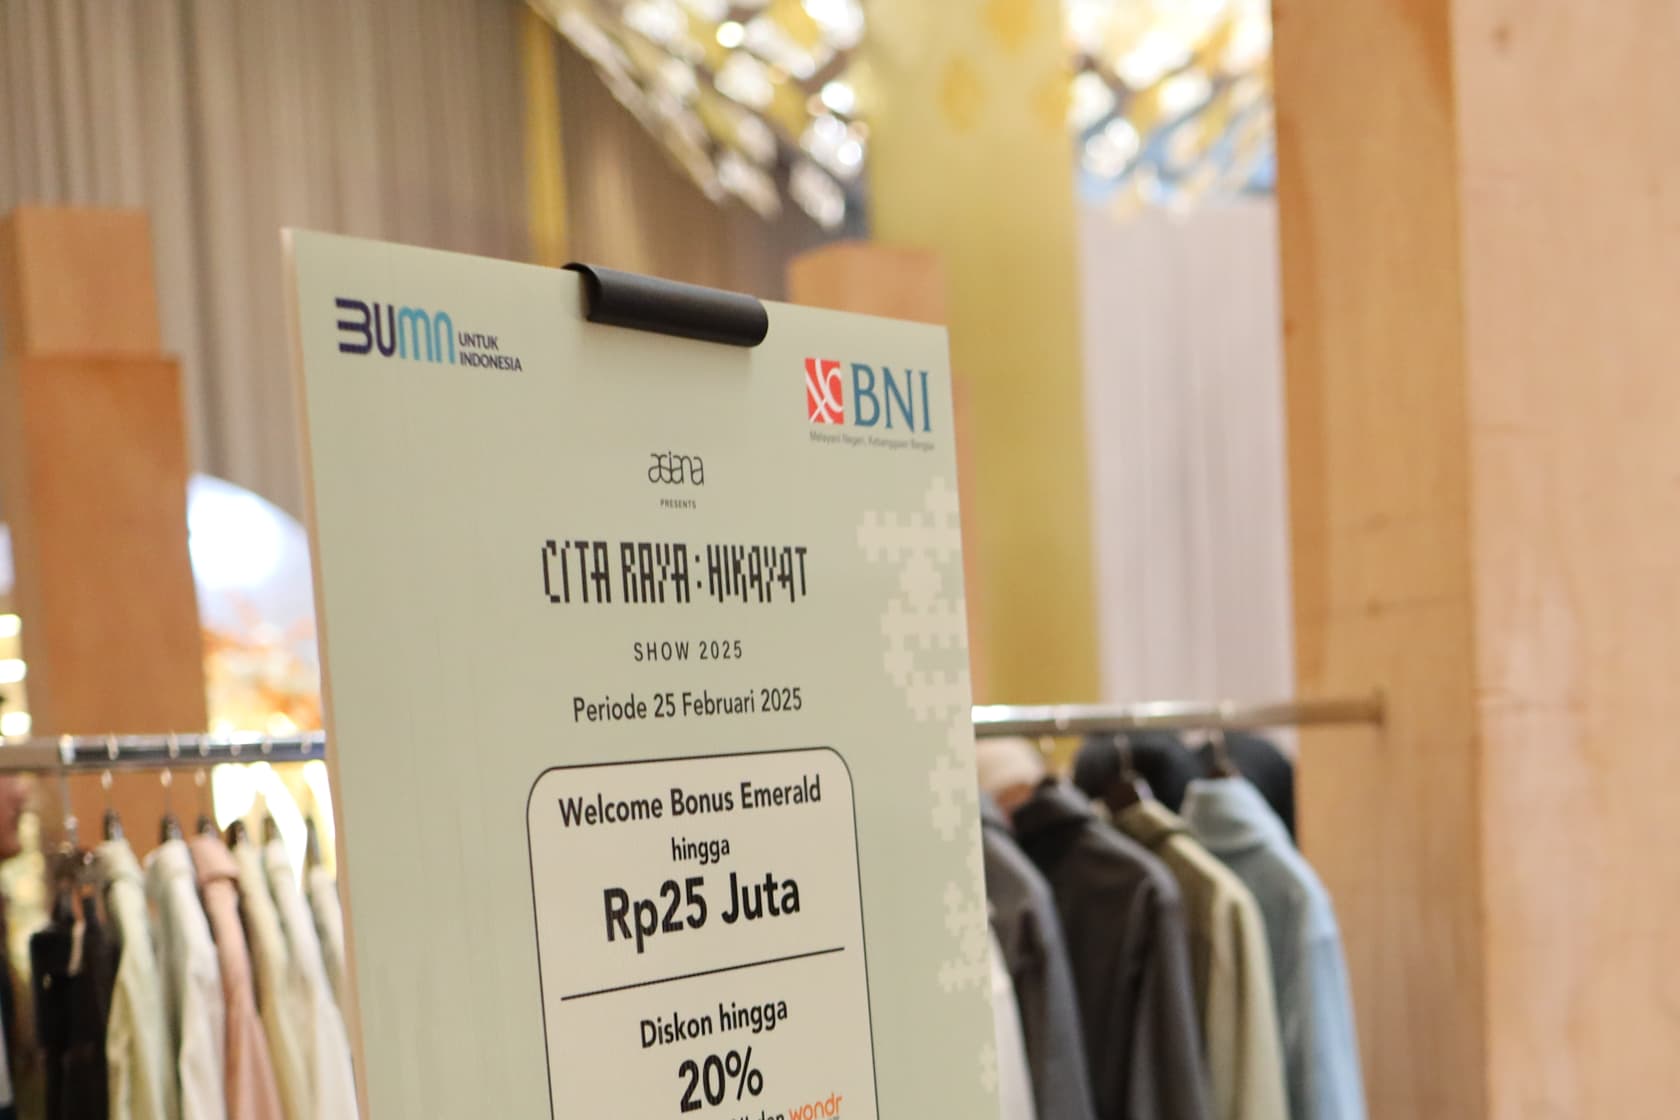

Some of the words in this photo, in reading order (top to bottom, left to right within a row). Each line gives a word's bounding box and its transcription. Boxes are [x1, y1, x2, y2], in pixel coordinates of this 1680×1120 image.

[458, 332, 499, 350] UNTUK
[459, 351, 522, 372] INDONESIA
[850, 362, 931, 433] BNI
[660, 498, 697, 509] PRESENTS
[541, 539, 612, 604] CITA
[619, 541, 691, 604] RAYA
[706, 543, 808, 604] HIKAYAT
[633, 641, 690, 662] SHOW
[699, 639, 743, 660] 2025
[572, 692, 648, 723] Periode
[653, 691, 677, 718] 25
[682, 689, 756, 716] Februari
[760, 686, 803, 712] 2025
[558, 793, 664, 828] Welcome
[669, 787, 735, 817] Bonus
[740, 773, 822, 809] Emerald
[671, 836, 731, 865] hingga
[603, 876, 708, 954] Rp25
[721, 871, 801, 924] Juta
[640, 1011, 713, 1049] Diskon
[718, 1000, 788, 1035] hingga
[678, 1045, 764, 1114] 20%
